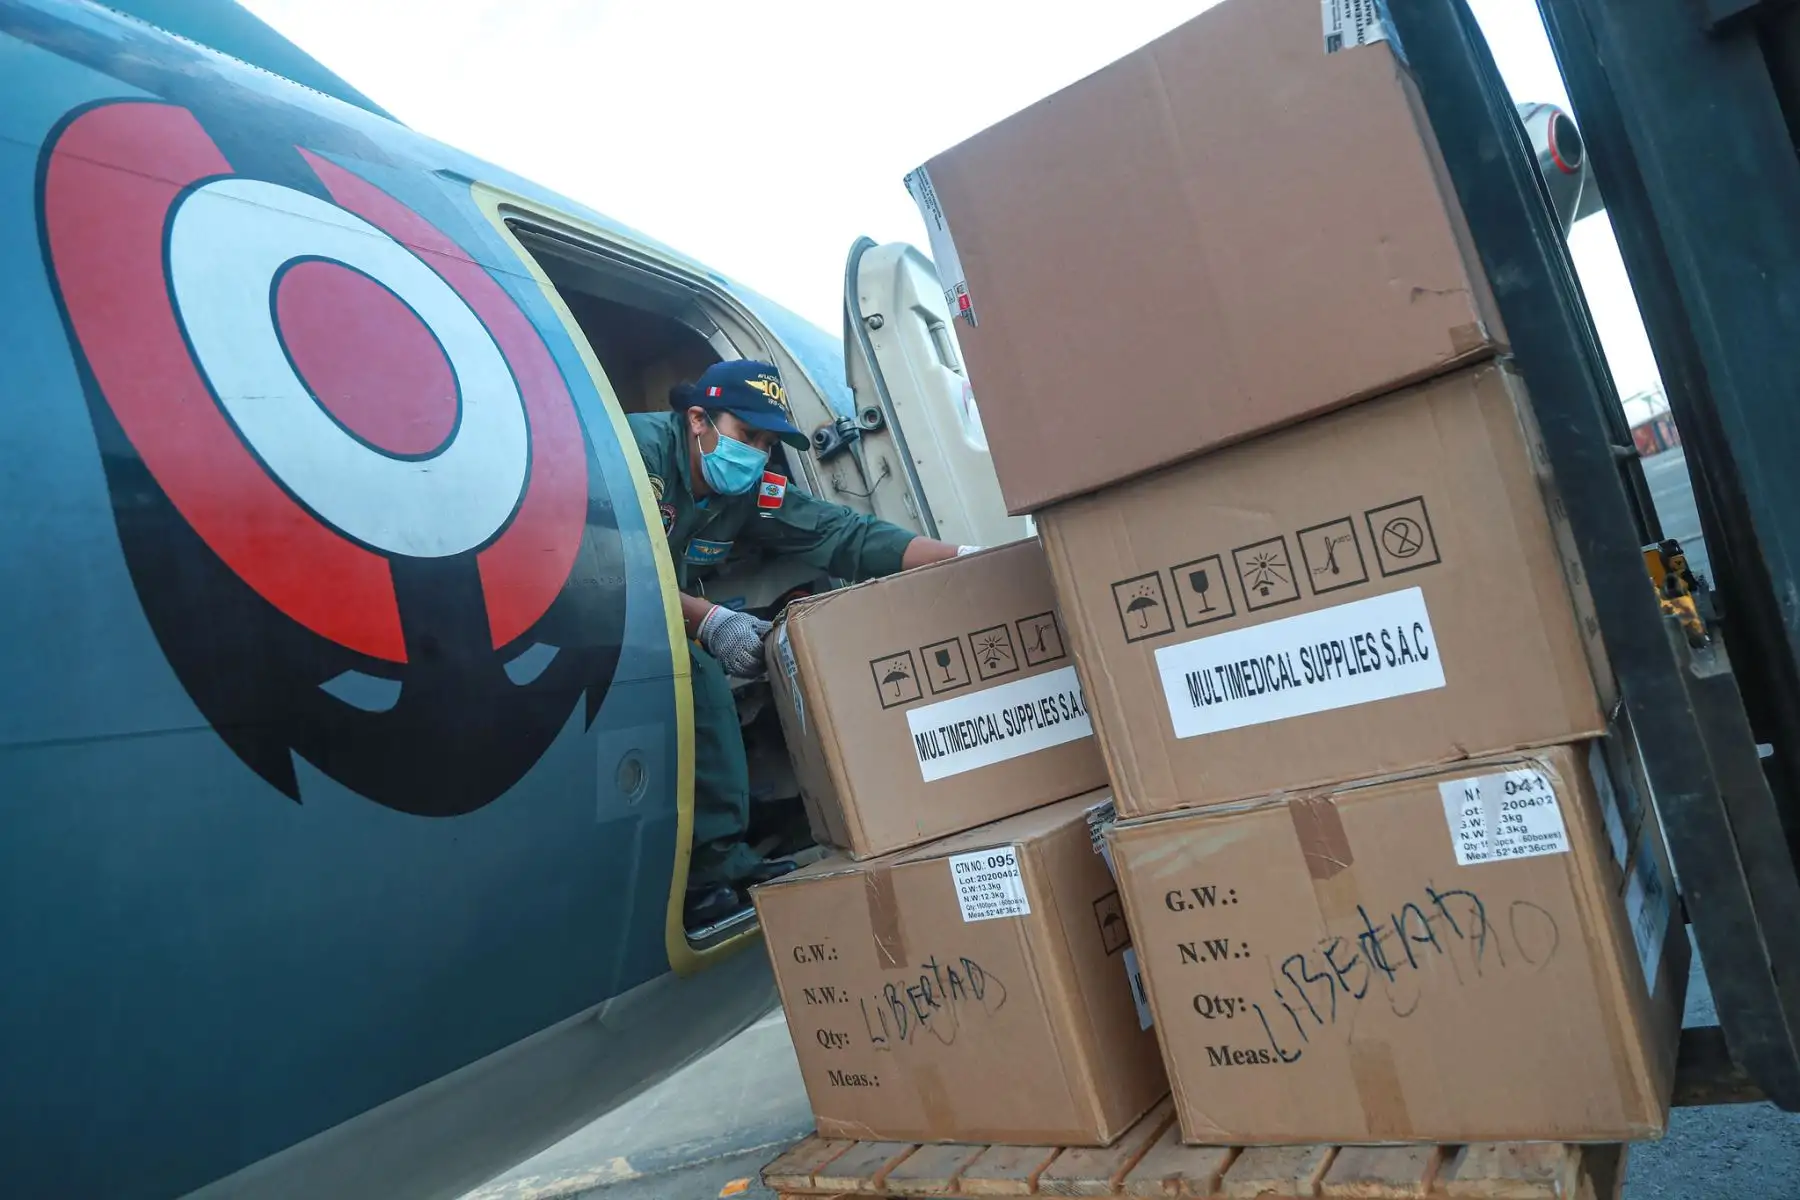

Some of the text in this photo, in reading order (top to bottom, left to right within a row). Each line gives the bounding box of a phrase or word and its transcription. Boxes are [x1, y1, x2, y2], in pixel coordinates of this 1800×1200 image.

[1185, 622, 1429, 708] MULTIMEDICAL SUPPLIES S.A.C
[914, 713, 1005, 762] MULTIMEDICAL
[1002, 696, 1060, 737] SUPPLIES
[955, 862, 970, 874] CTN
[987, 854, 1014, 868] 095
[959, 870, 1019, 885] Lot:20200402
[1165, 887, 1238, 912] G.W.:
[793, 944, 838, 964] G.W.:
[1177, 939, 1250, 964] N.W.:
[802, 986, 849, 1005] N.W.:
[1193, 994, 1247, 1019] Qty:
[816, 1029, 849, 1049] Qty:
[828, 1070, 880, 1087] Meas.:
